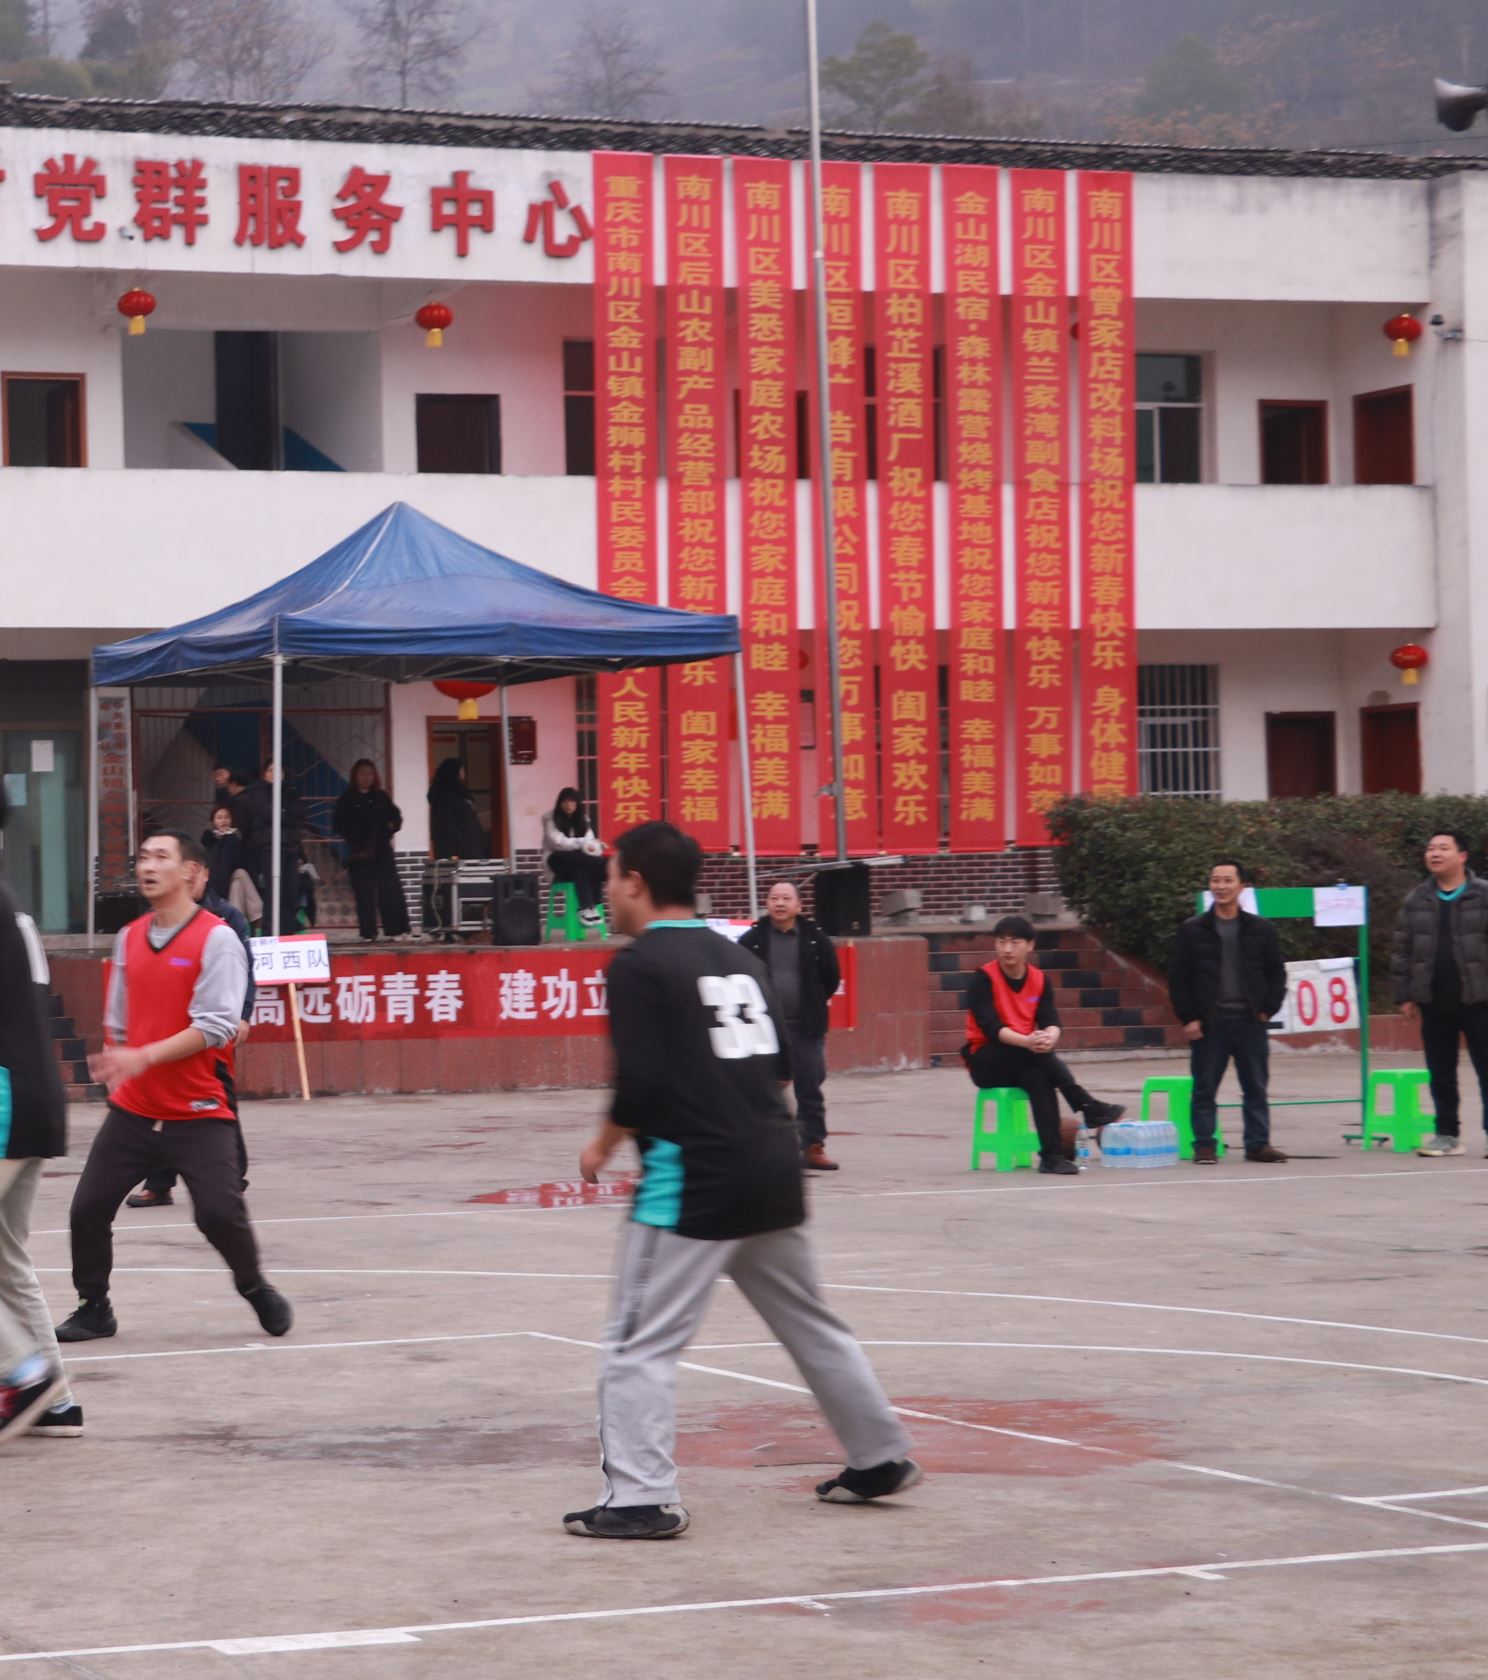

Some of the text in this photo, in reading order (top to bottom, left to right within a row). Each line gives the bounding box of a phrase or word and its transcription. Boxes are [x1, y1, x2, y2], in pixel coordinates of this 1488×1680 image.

[1021, 188, 1064, 689] 南川区金山镇兰家湾副食店祝您新年快乐
[680, 711, 720, 822] 阖家幸福
[751, 691, 790, 820] 幸福美满
[891, 690, 930, 825] 阖家欢乐
[959, 718, 997, 821] 幸福美满
[252, 950, 329, 970] 河西队
[1296, 977, 1351, 1026] 08
[696, 974, 779, 1059] 33
